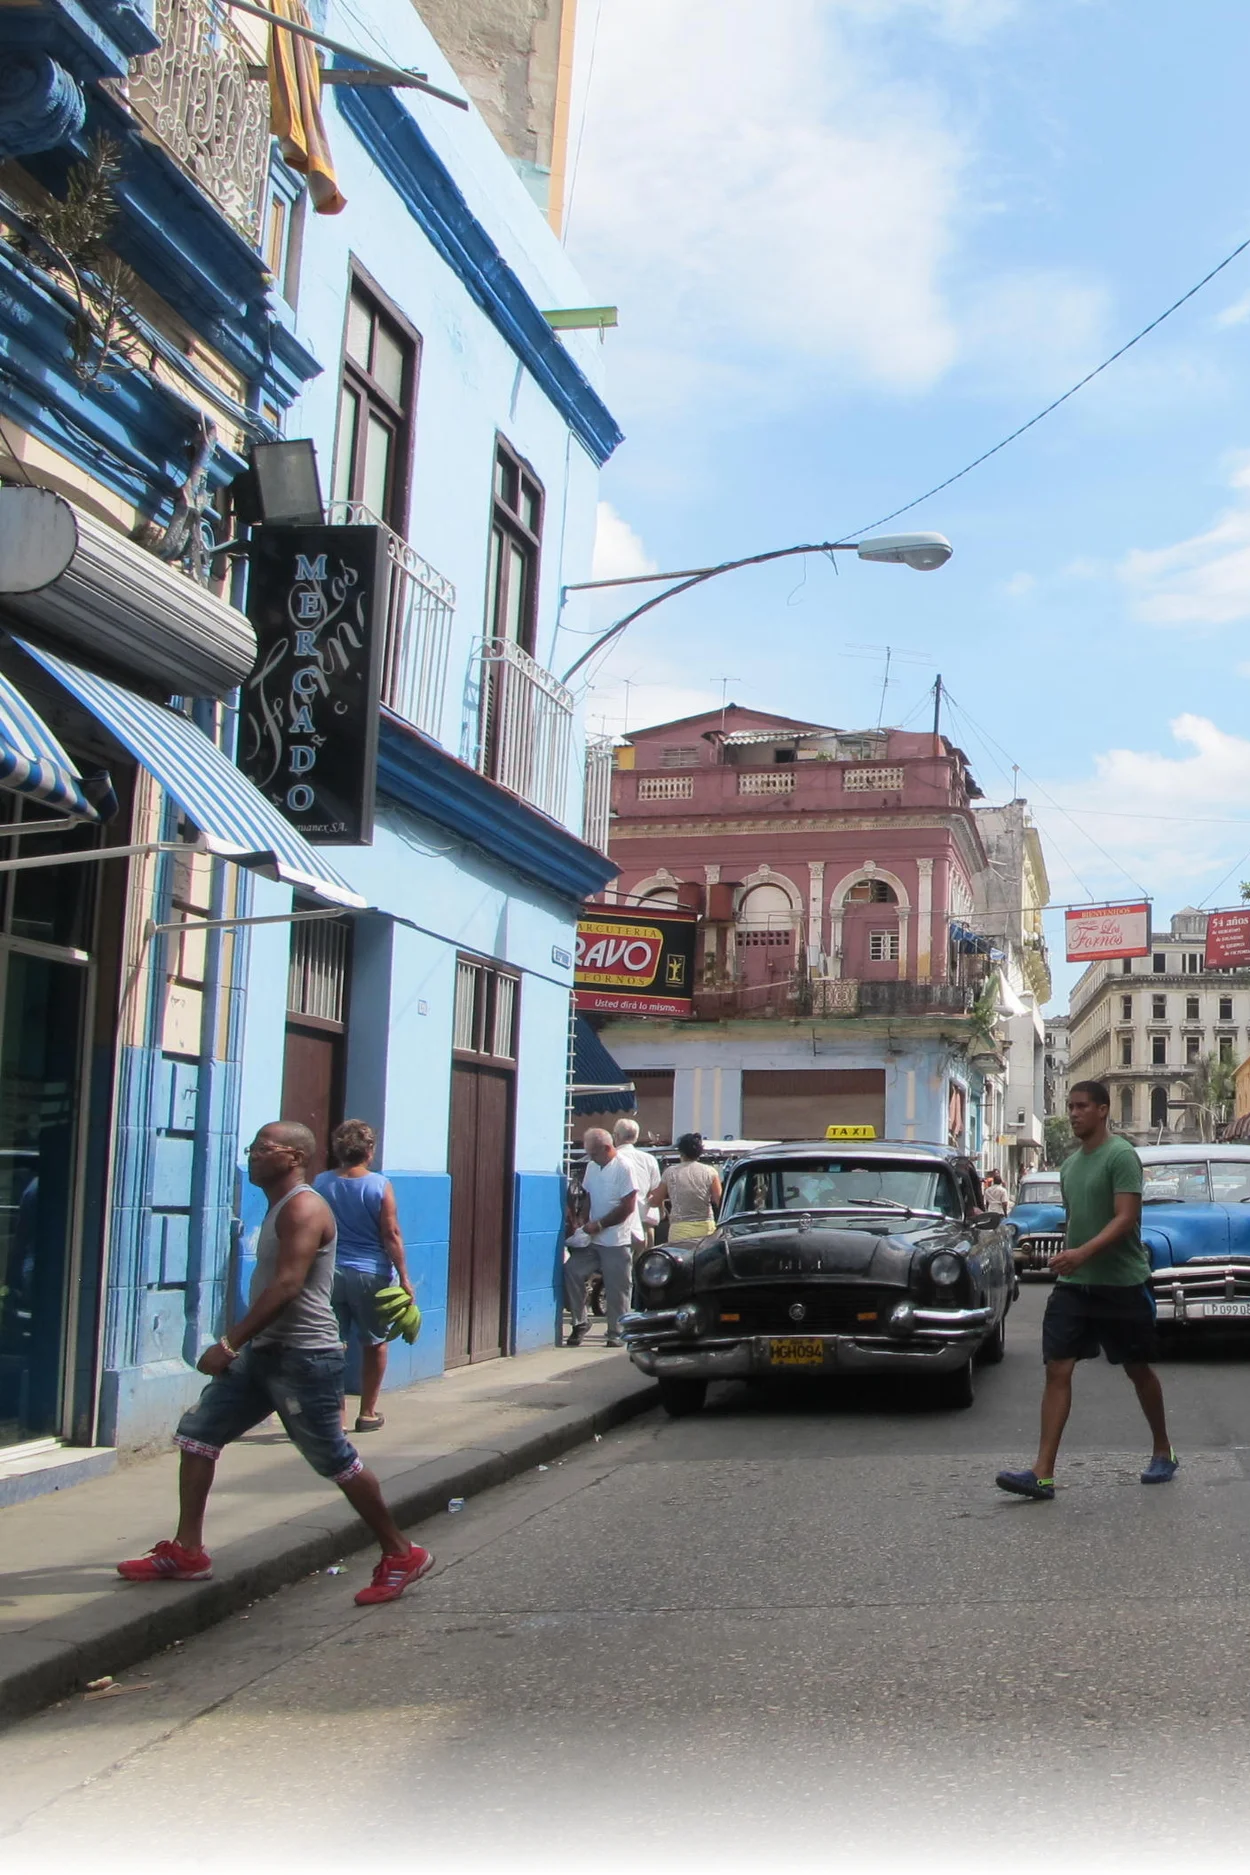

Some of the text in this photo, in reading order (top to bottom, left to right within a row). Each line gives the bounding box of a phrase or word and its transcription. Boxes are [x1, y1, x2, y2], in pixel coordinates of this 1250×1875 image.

[286, 553, 328, 811] MERCADO
[1082, 907, 1131, 918] BIENVENIDOS
[1101, 919, 1120, 934] Los
[1226, 916, 1249, 926] años
[576, 923, 657, 938] ARCUTERIA
[1069, 925, 1123, 950] Fornos
[575, 936, 652, 971] RAVO
[583, 973, 645, 986] FORNOS
[594, 999, 618, 1009] Usted
[639, 1002, 648, 1010] lo
[830, 1127, 866, 1136] TAXI
